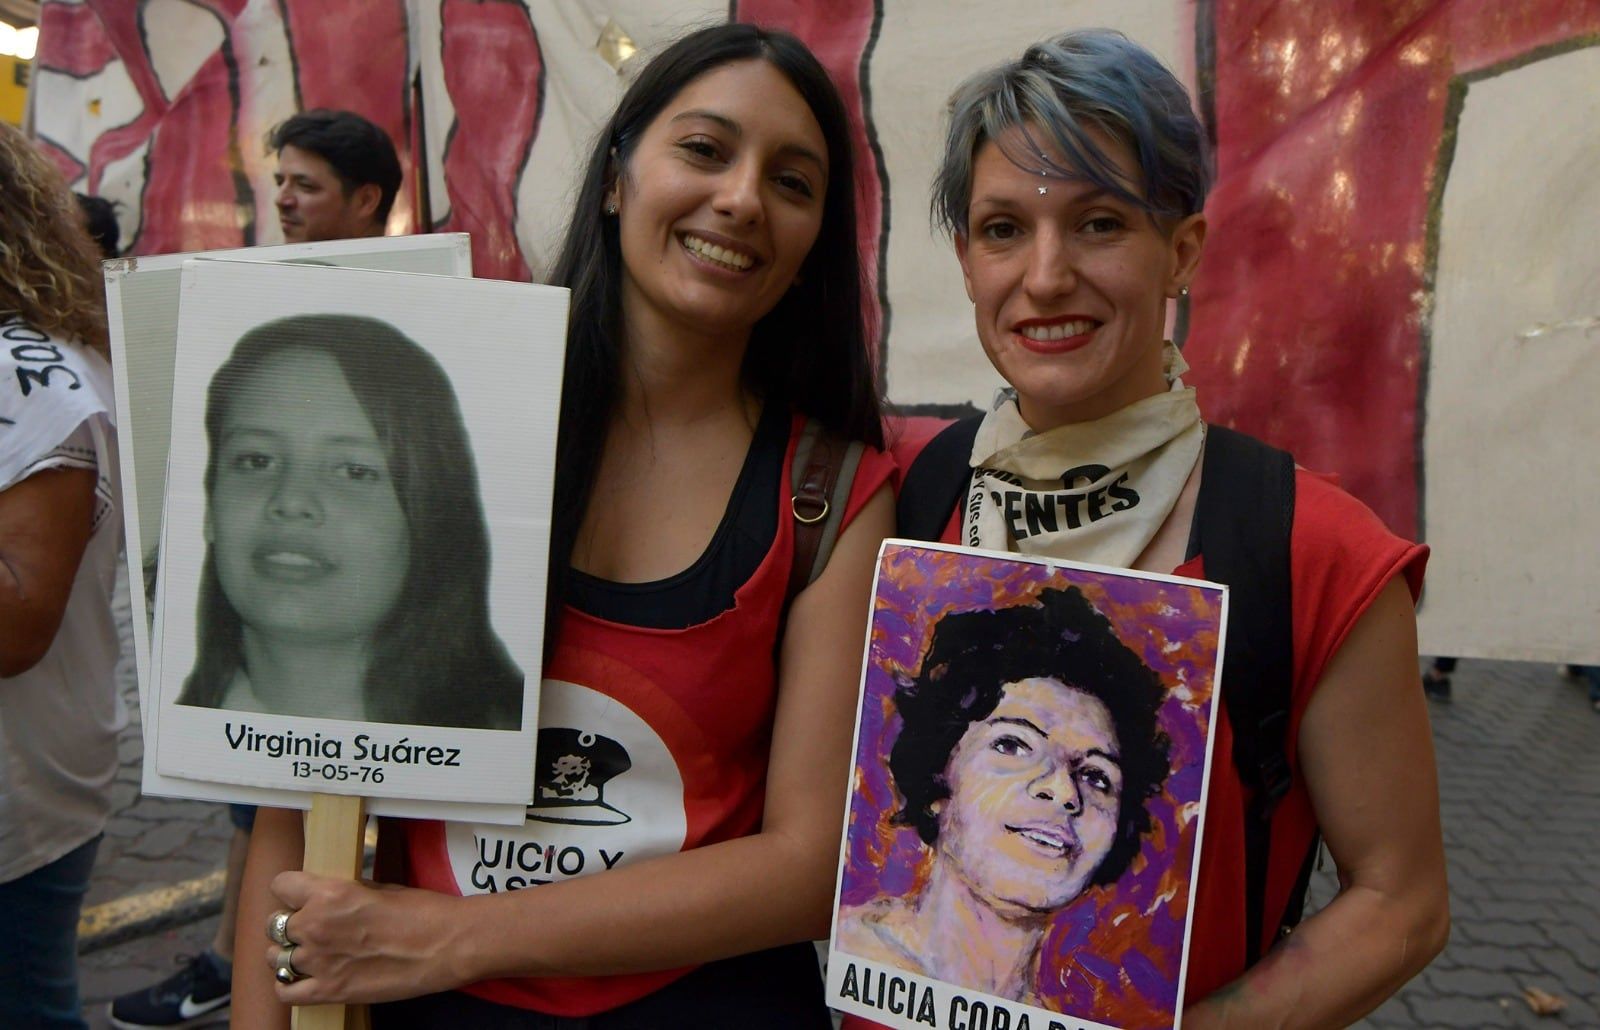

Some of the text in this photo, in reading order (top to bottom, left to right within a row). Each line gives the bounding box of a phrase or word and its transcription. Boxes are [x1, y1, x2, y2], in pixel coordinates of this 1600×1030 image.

[225, 723, 461, 767] Virginia Suárez
[292, 761, 385, 784] 13-05-76
[474, 835, 585, 876] UICIO
[840, 963, 937, 1028] ALICIA
